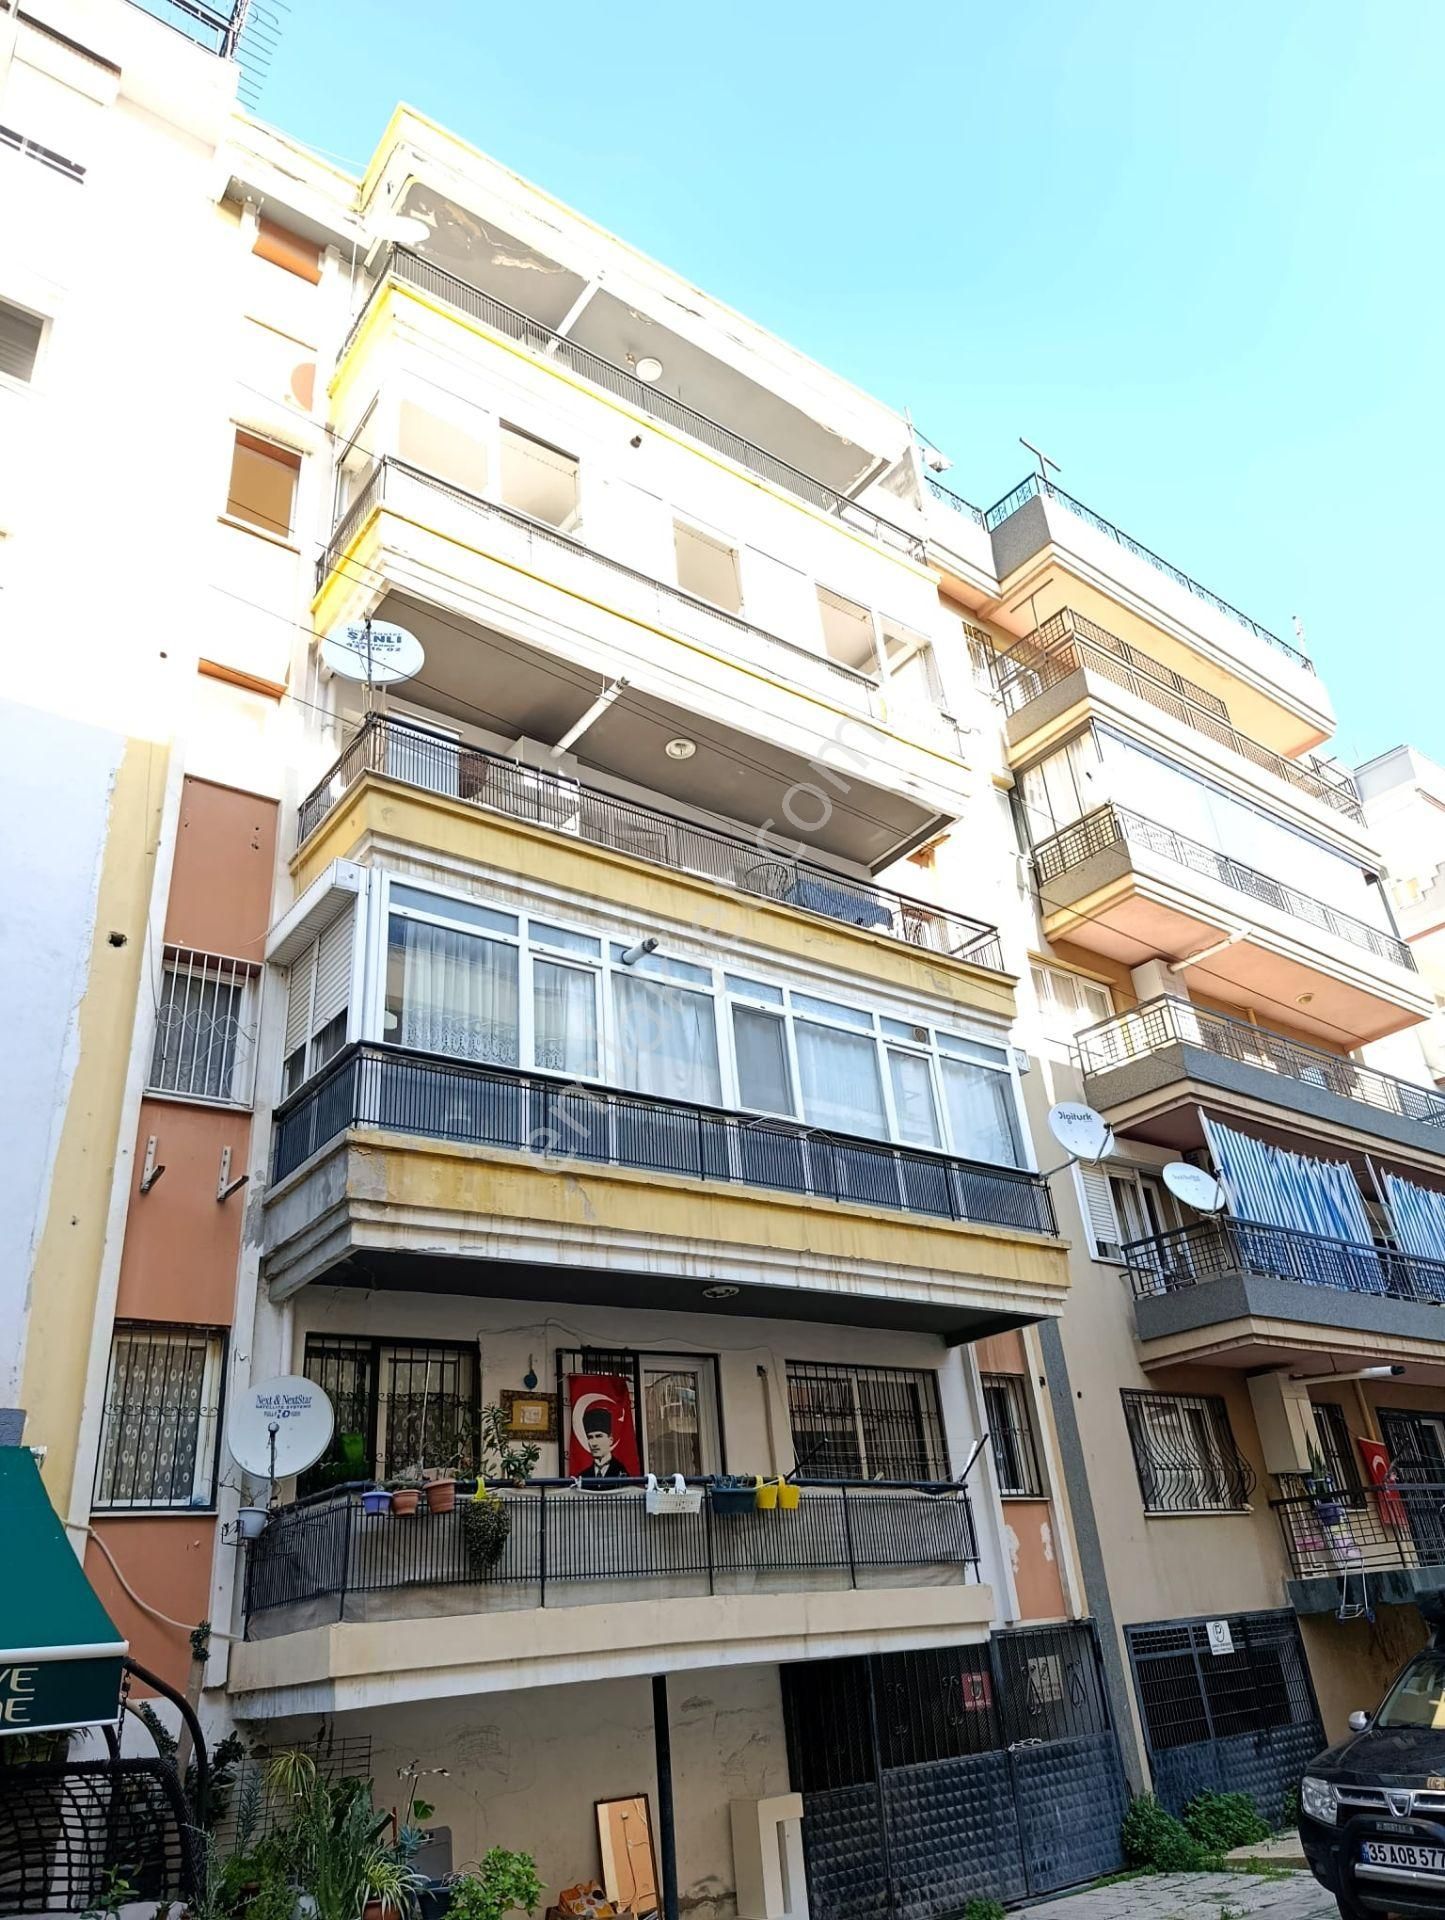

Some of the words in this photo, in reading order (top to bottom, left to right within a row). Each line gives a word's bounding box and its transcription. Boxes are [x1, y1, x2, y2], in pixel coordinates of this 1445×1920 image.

[255, 1394, 272, 1405] Next
[273, 1394, 281, 1405] &
[282, 1394, 313, 1405] NextStar
[1368, 1844, 1386, 1862] 35
[1390, 1846, 1417, 1865] AOB
[1419, 1848, 1445, 1868] 577
